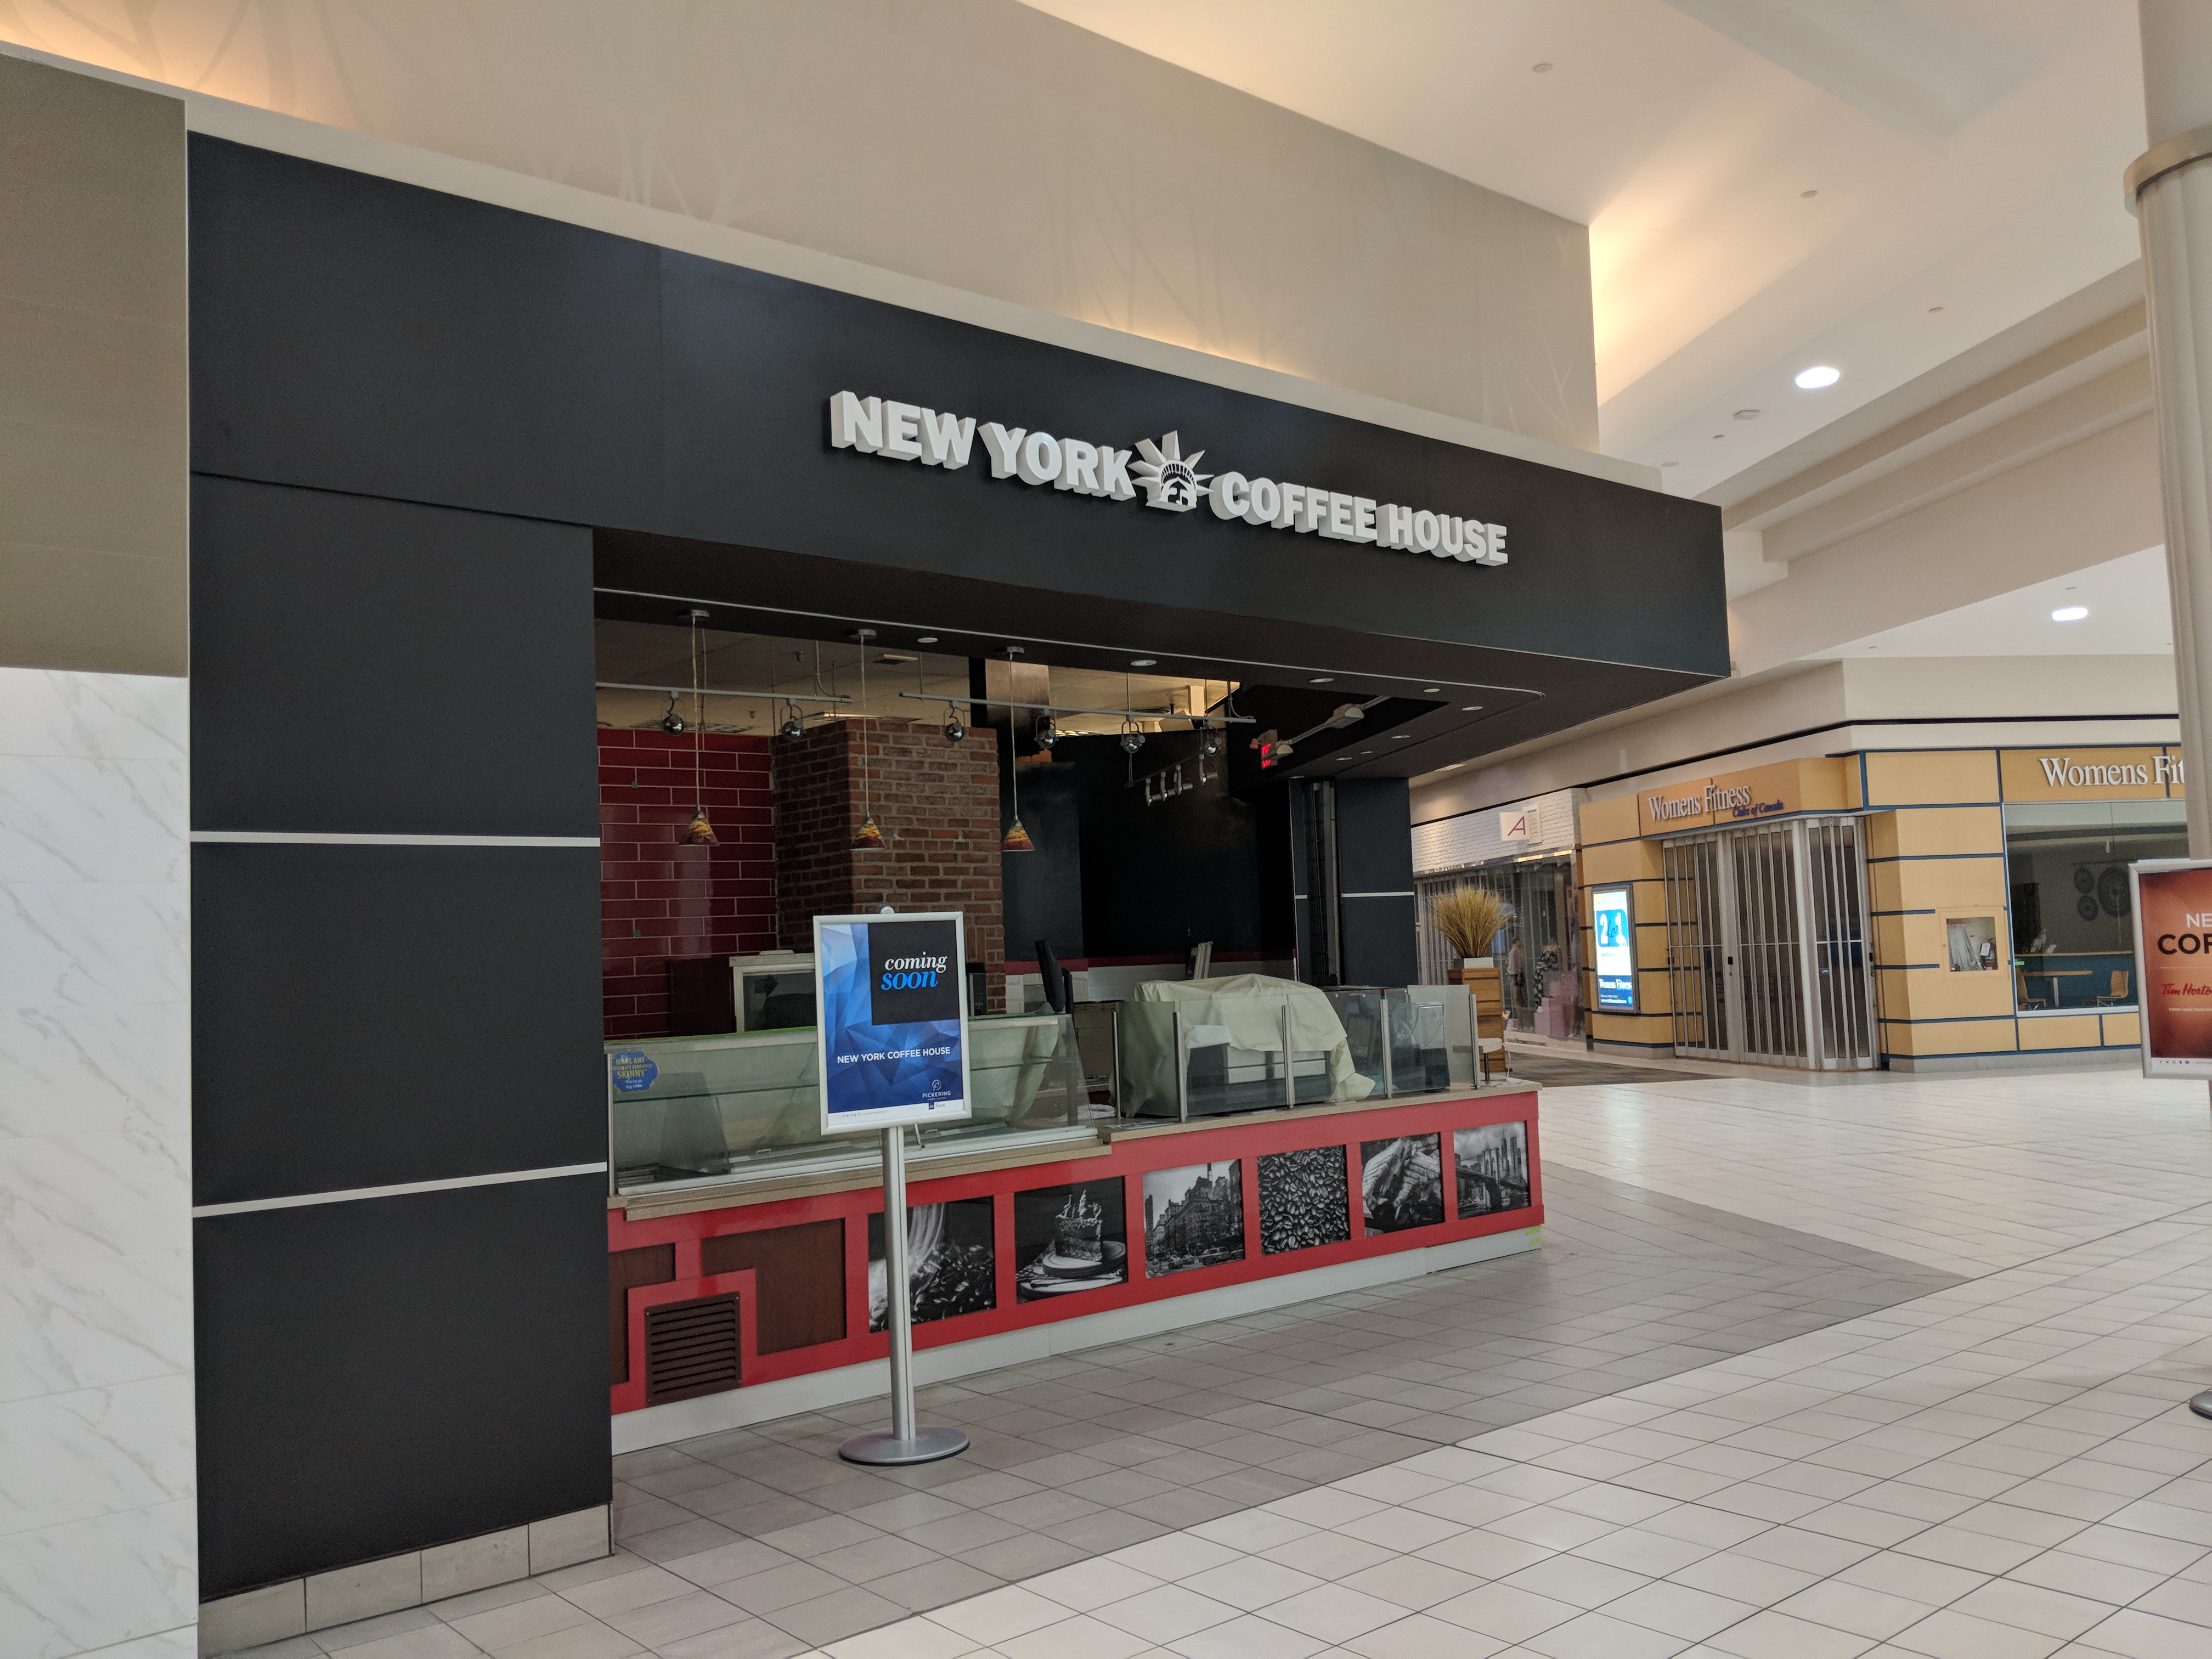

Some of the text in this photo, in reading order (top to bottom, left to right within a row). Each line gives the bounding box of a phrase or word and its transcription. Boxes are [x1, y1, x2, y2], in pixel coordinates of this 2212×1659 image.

[830, 390, 1509, 567] NEW YORK COFFEE HOUSE
[2039, 757, 2148, 787] Womens
[1648, 784, 1751, 822] Womens Fitness
[1507, 816, 1526, 837] A
[1600, 913, 1609, 944] 2
[1615, 912, 1628, 944] 1
[2186, 913, 2212, 928] NE
[884, 951, 948, 974] coming
[881, 970, 939, 991] soon
[2161, 983, 2212, 996] Tim Horto
[837, 1046, 951, 1064] NEW YORK COFFEE HOUSE
[922, 1090, 952, 1098] PICKERING
